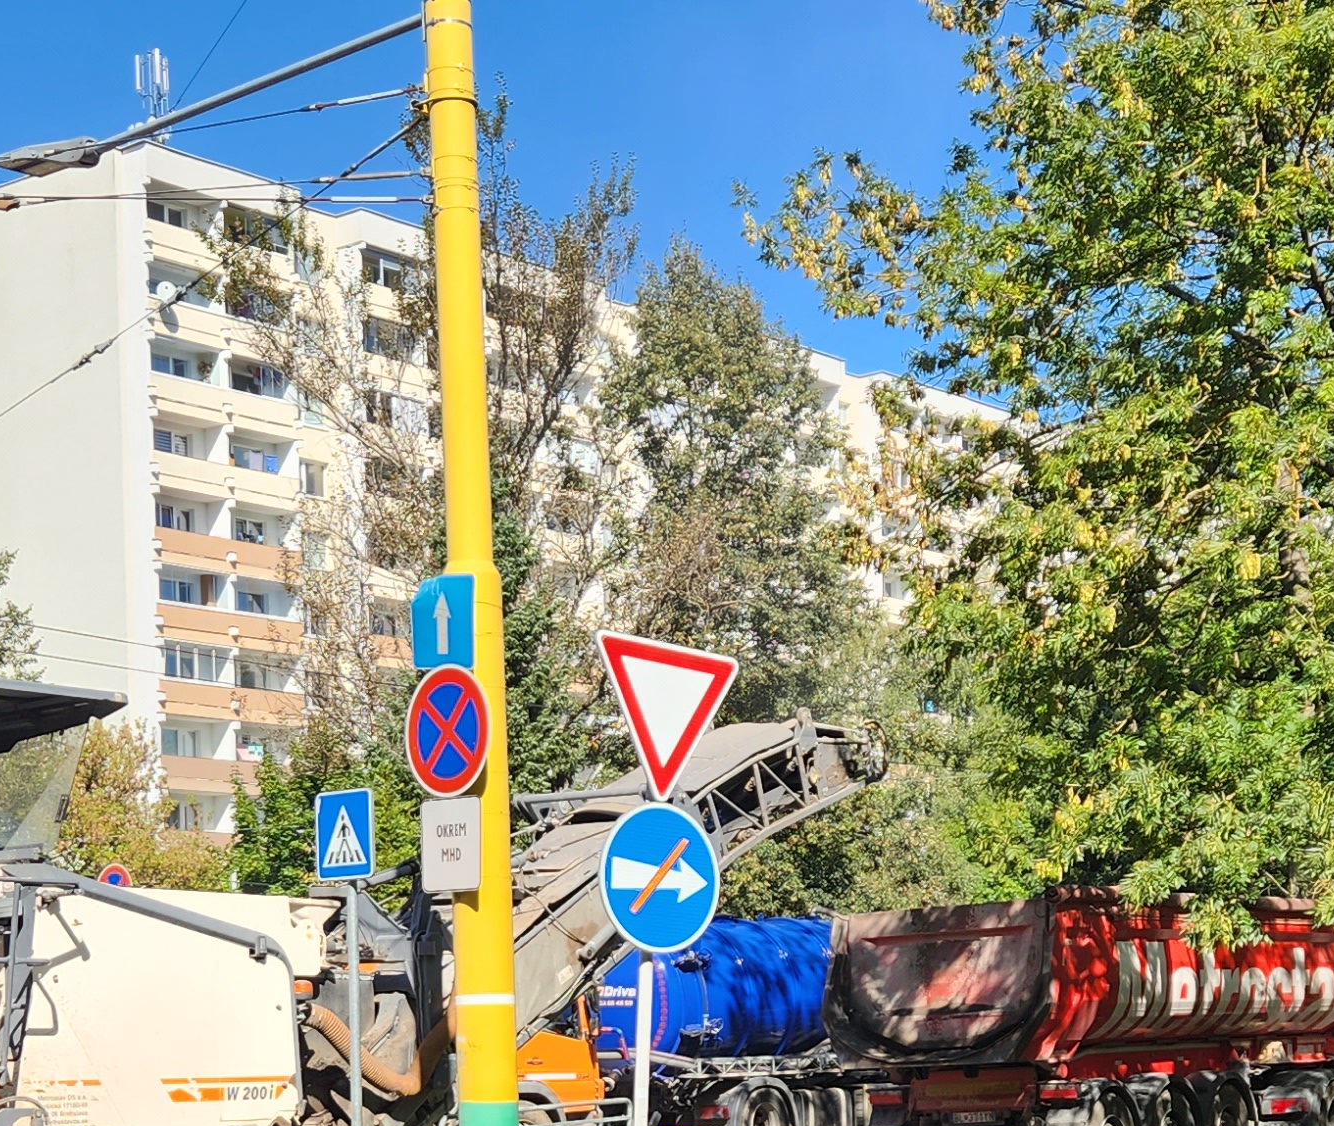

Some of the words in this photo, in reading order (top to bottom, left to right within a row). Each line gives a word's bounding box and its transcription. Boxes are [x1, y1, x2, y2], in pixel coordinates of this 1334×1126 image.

[436, 822, 467, 838] OKREM
[441, 847, 462, 862] MHD
[227, 1086, 240, 1101] W
